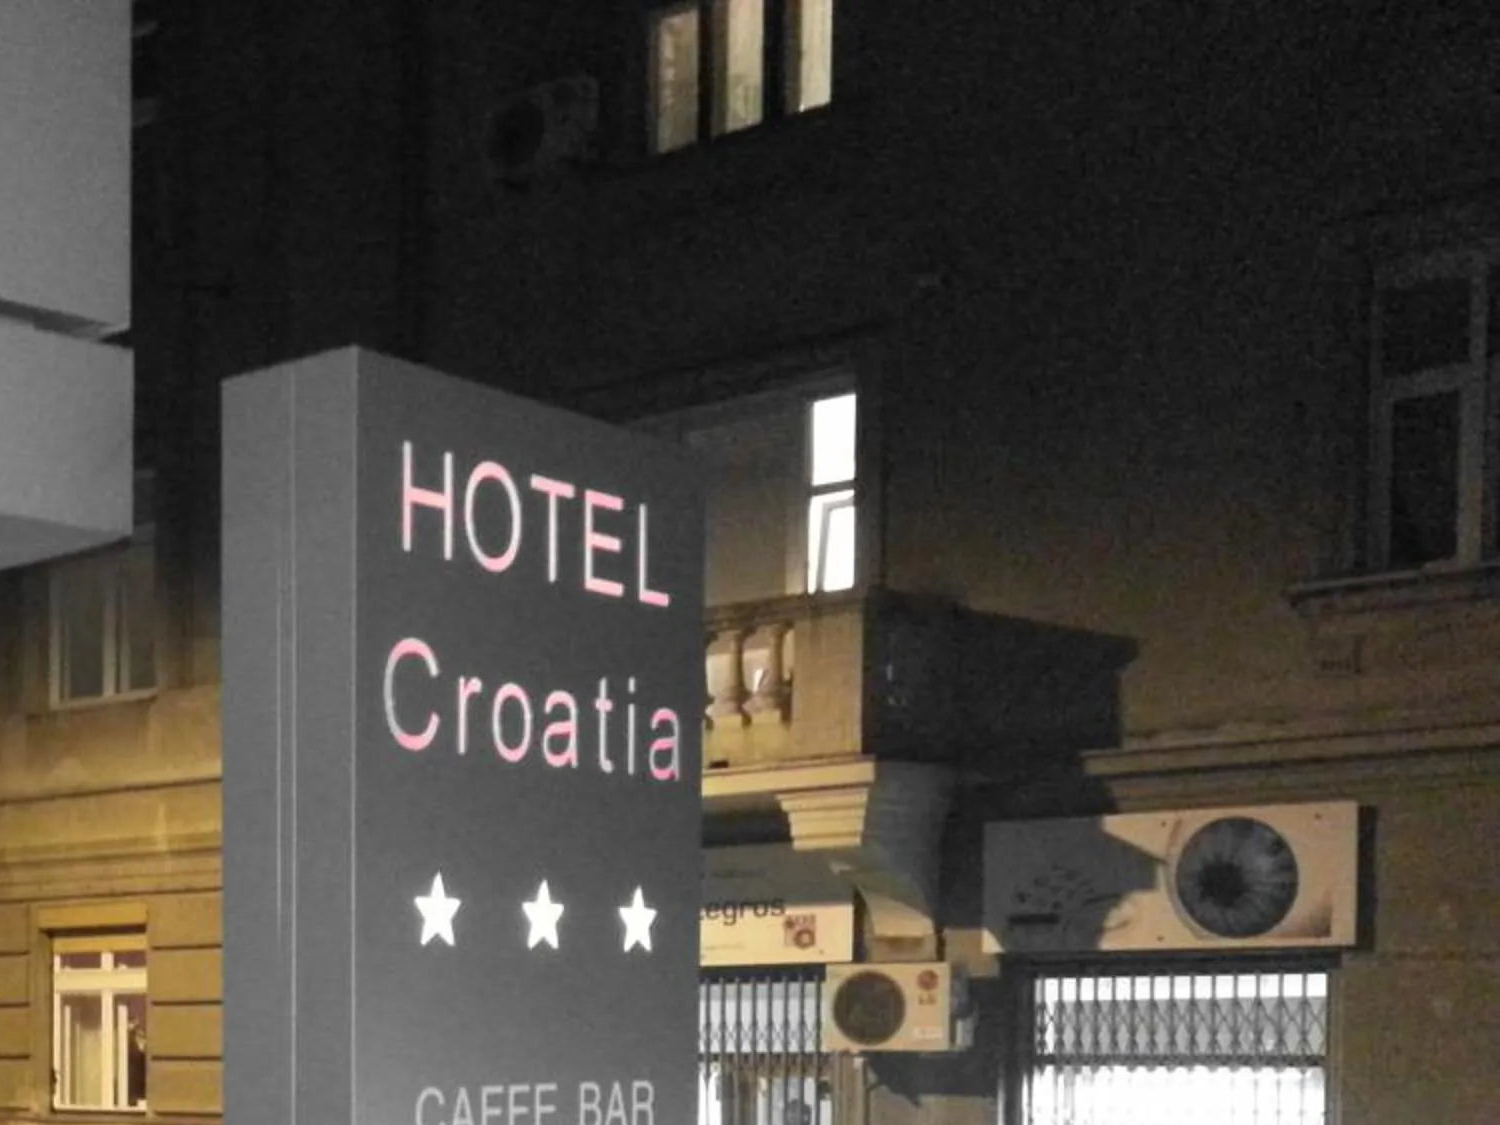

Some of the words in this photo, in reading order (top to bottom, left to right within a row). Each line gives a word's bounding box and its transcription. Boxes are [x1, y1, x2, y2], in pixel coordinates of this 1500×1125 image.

[403, 440, 670, 608] HOTEL
[384, 637, 680, 781] Croatia
[699, 899, 785, 926] egros
